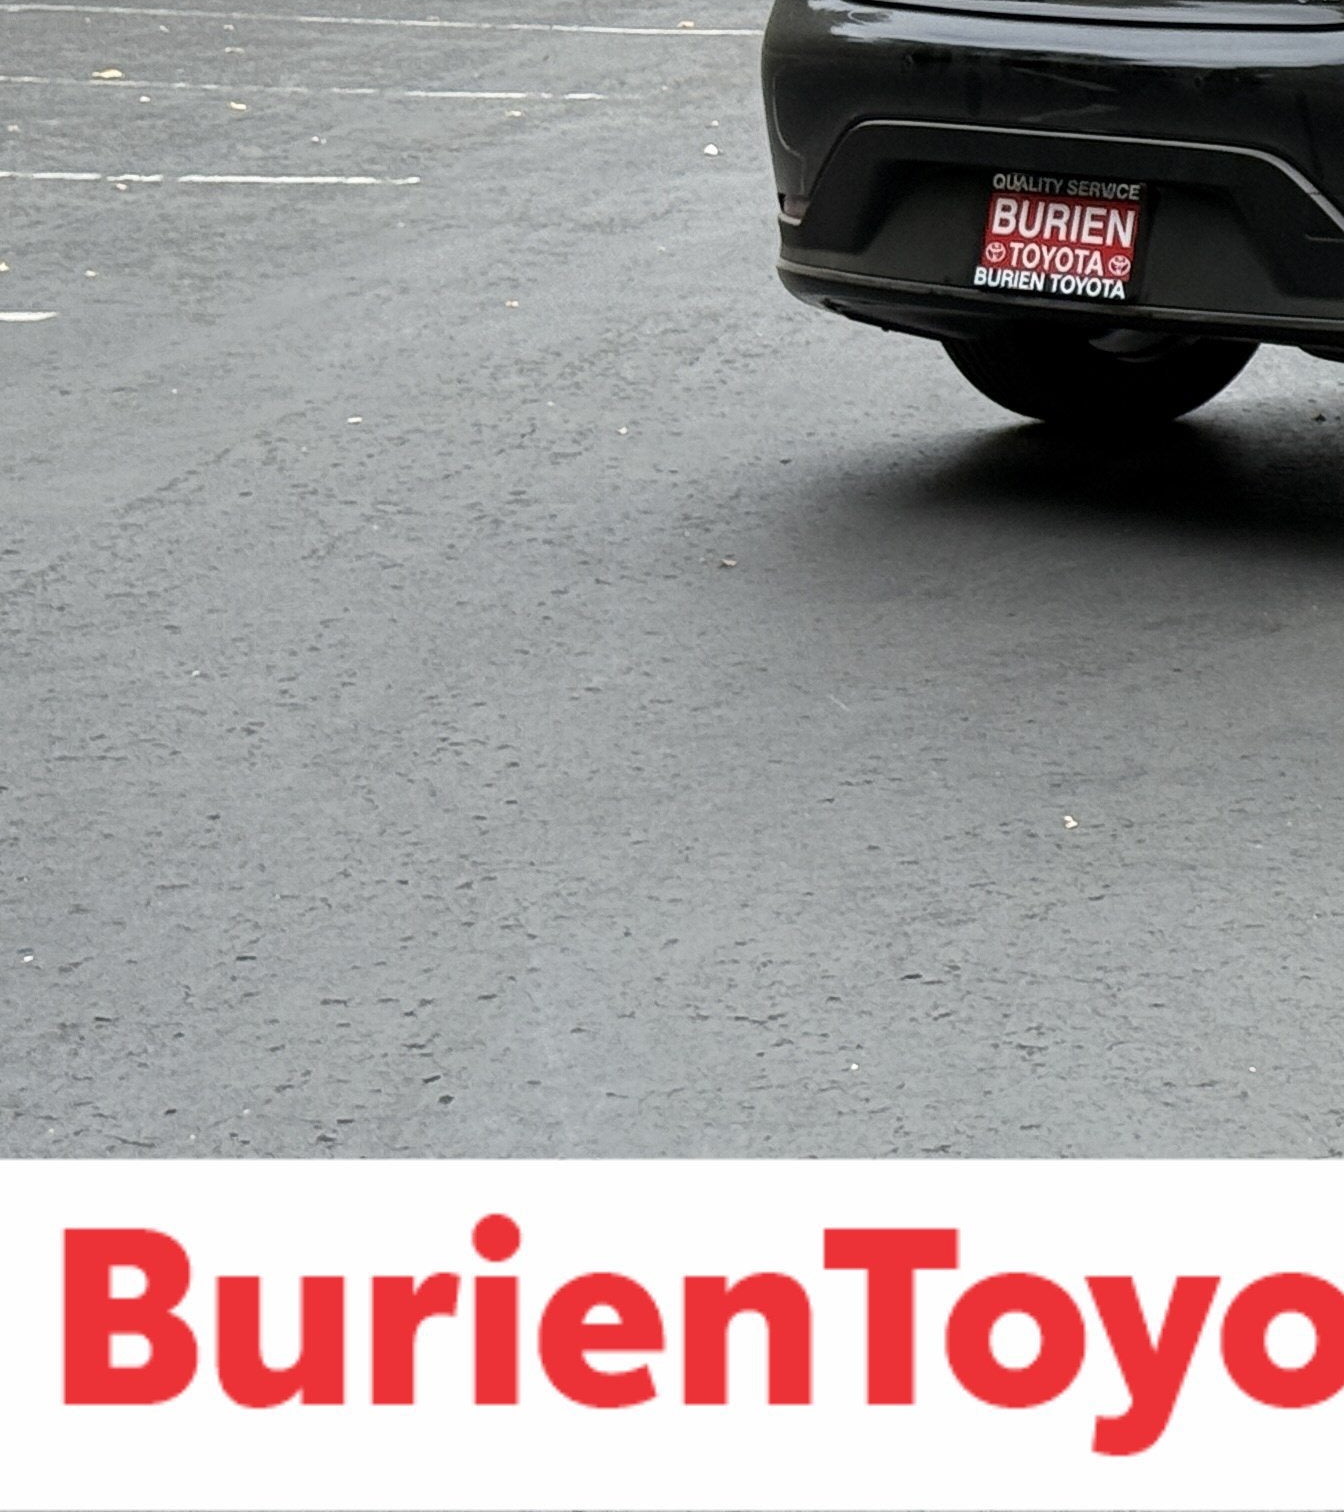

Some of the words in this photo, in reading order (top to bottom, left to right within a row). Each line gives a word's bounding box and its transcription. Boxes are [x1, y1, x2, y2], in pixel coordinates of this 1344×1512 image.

[992, 173, 1064, 194] QUALITY
[1067, 179, 1141, 200] SERVICE
[991, 197, 1136, 248] BURIEN
[1009, 241, 1104, 276] TOYOTA
[973, 266, 1046, 292] BURIEN
[1050, 273, 1126, 299] TOYOTA
